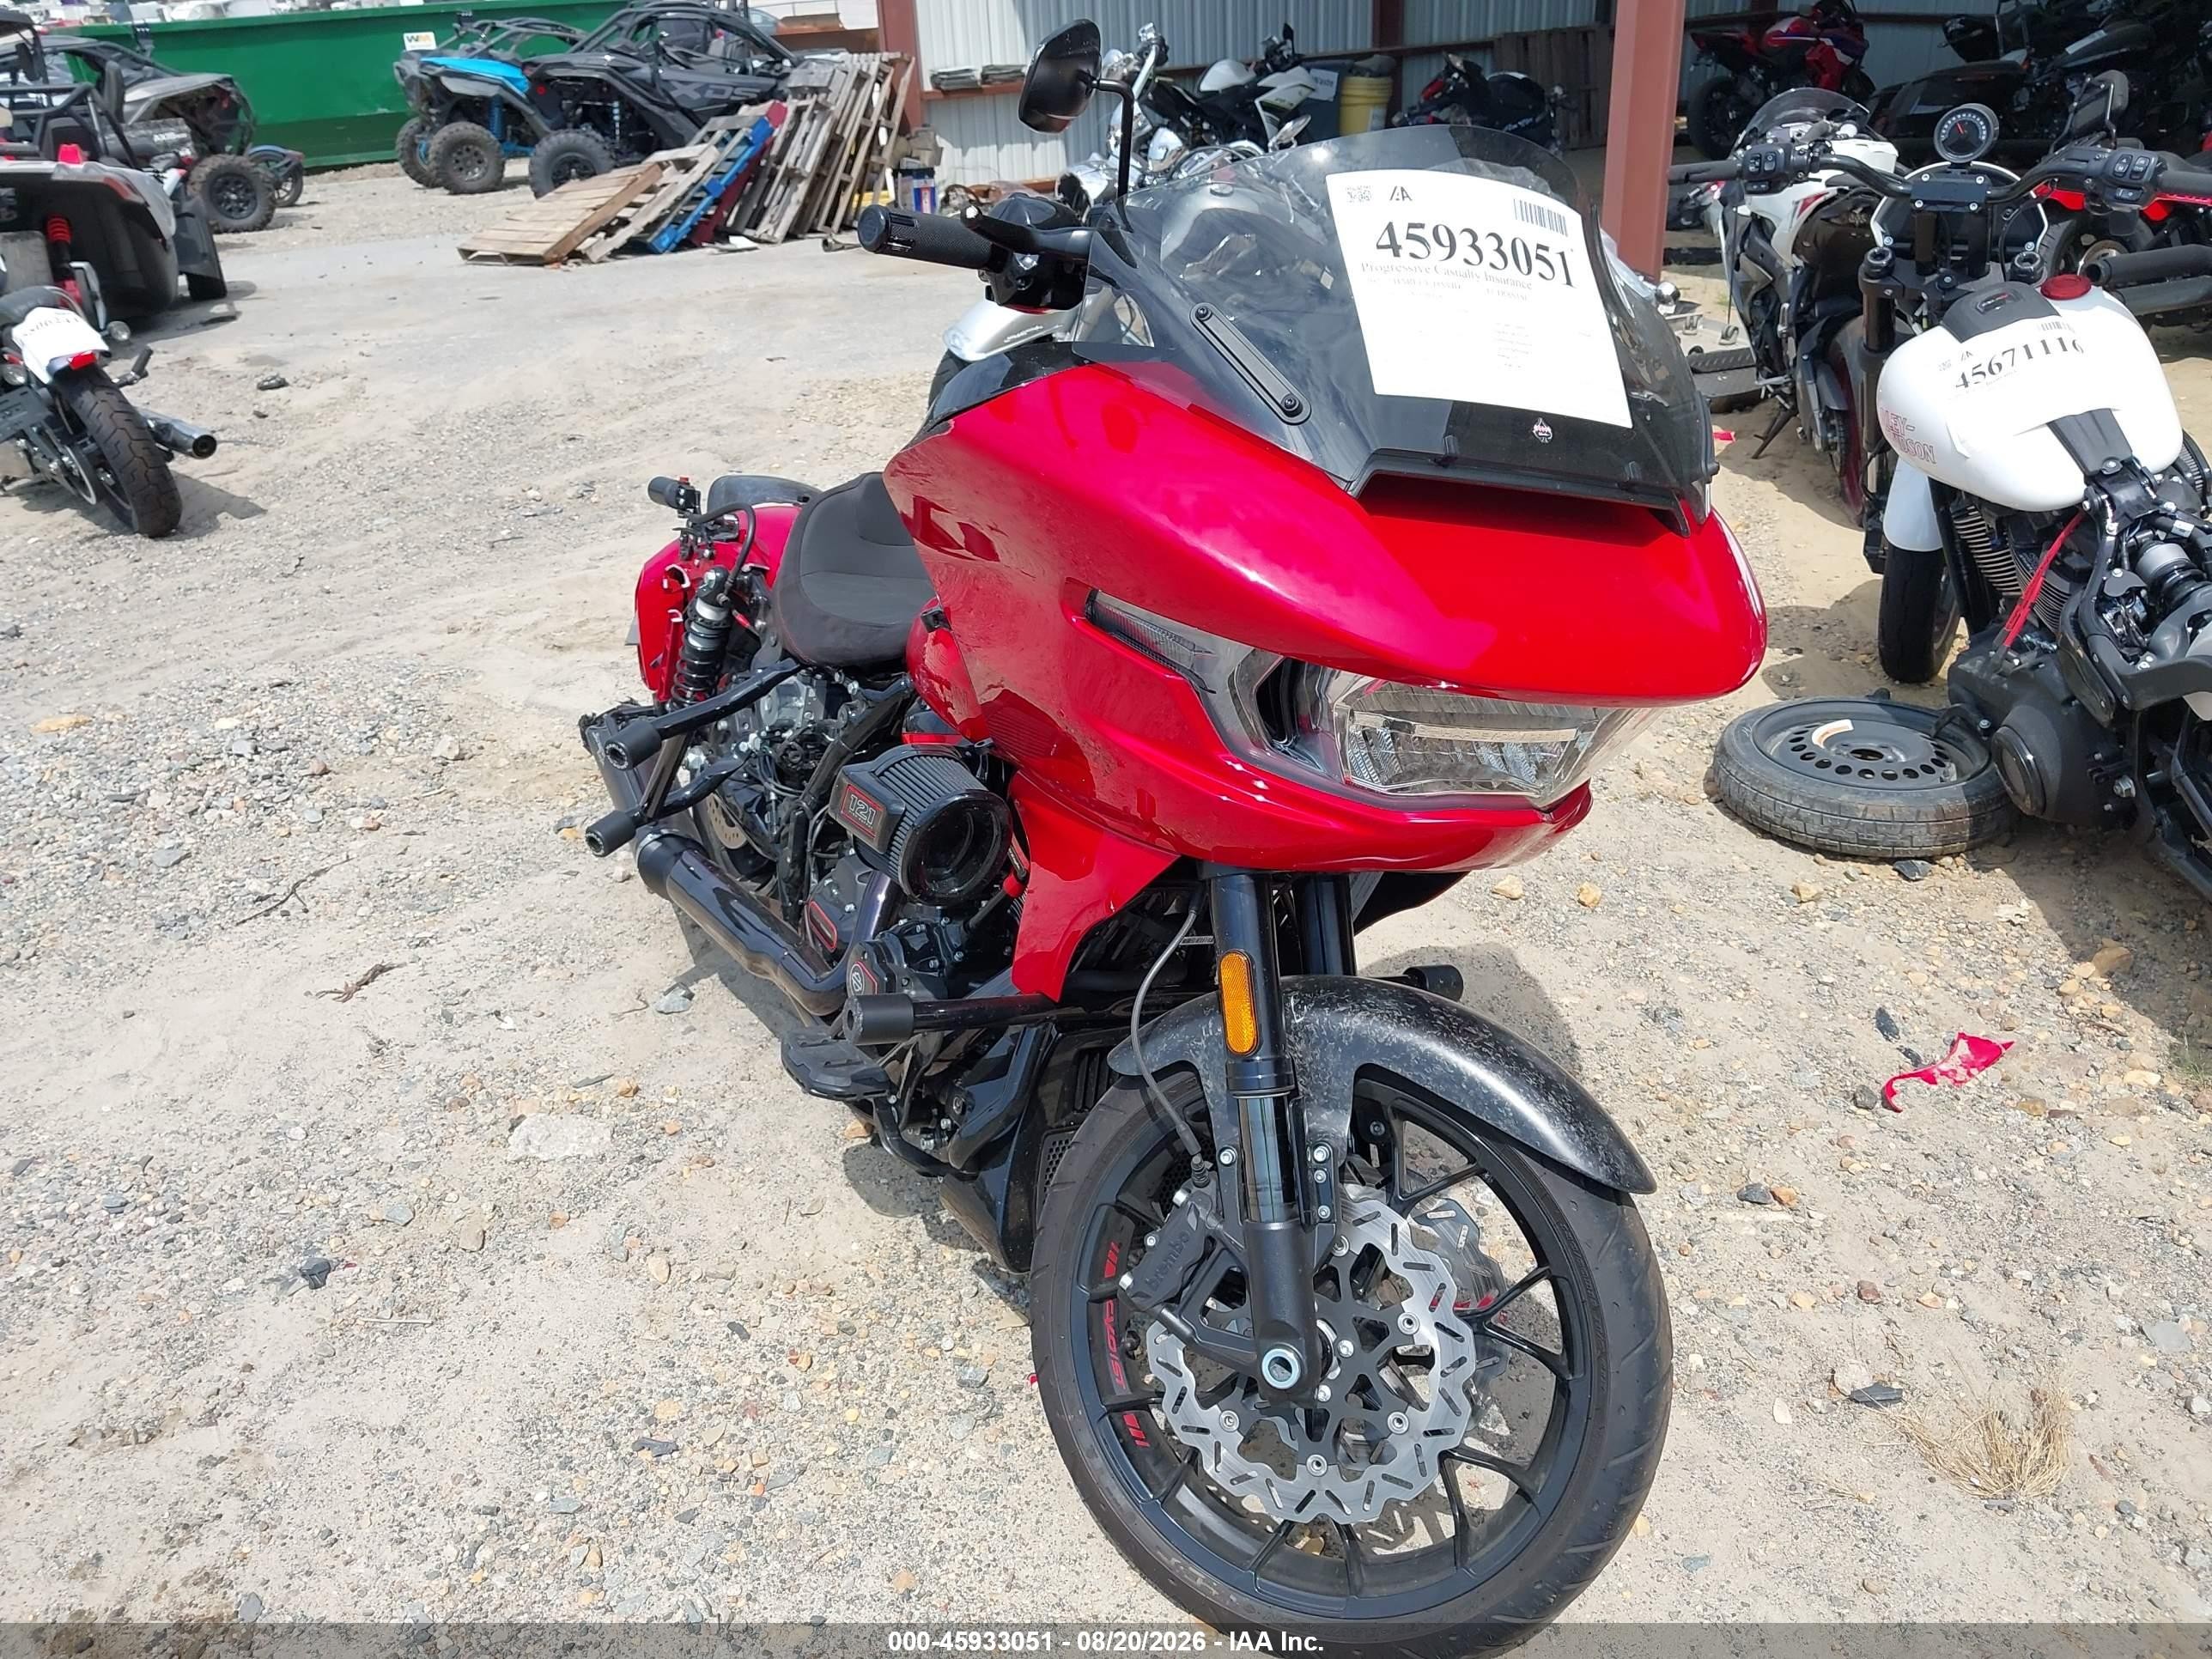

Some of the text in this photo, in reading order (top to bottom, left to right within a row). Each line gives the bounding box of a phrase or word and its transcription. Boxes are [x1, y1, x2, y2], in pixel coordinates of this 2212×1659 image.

[670, 81, 762, 100] XDS
[1376, 221, 1577, 288] 45933051
[1361, 262, 1431, 275] Progressive
[1434, 264, 1480, 283] Casualty
[1484, 270, 1533, 290] Insurance
[1955, 337, 2084, 388] 45671116
[849, 793, 877, 825] 121
[1146, 1231, 1190, 1291] brembo
